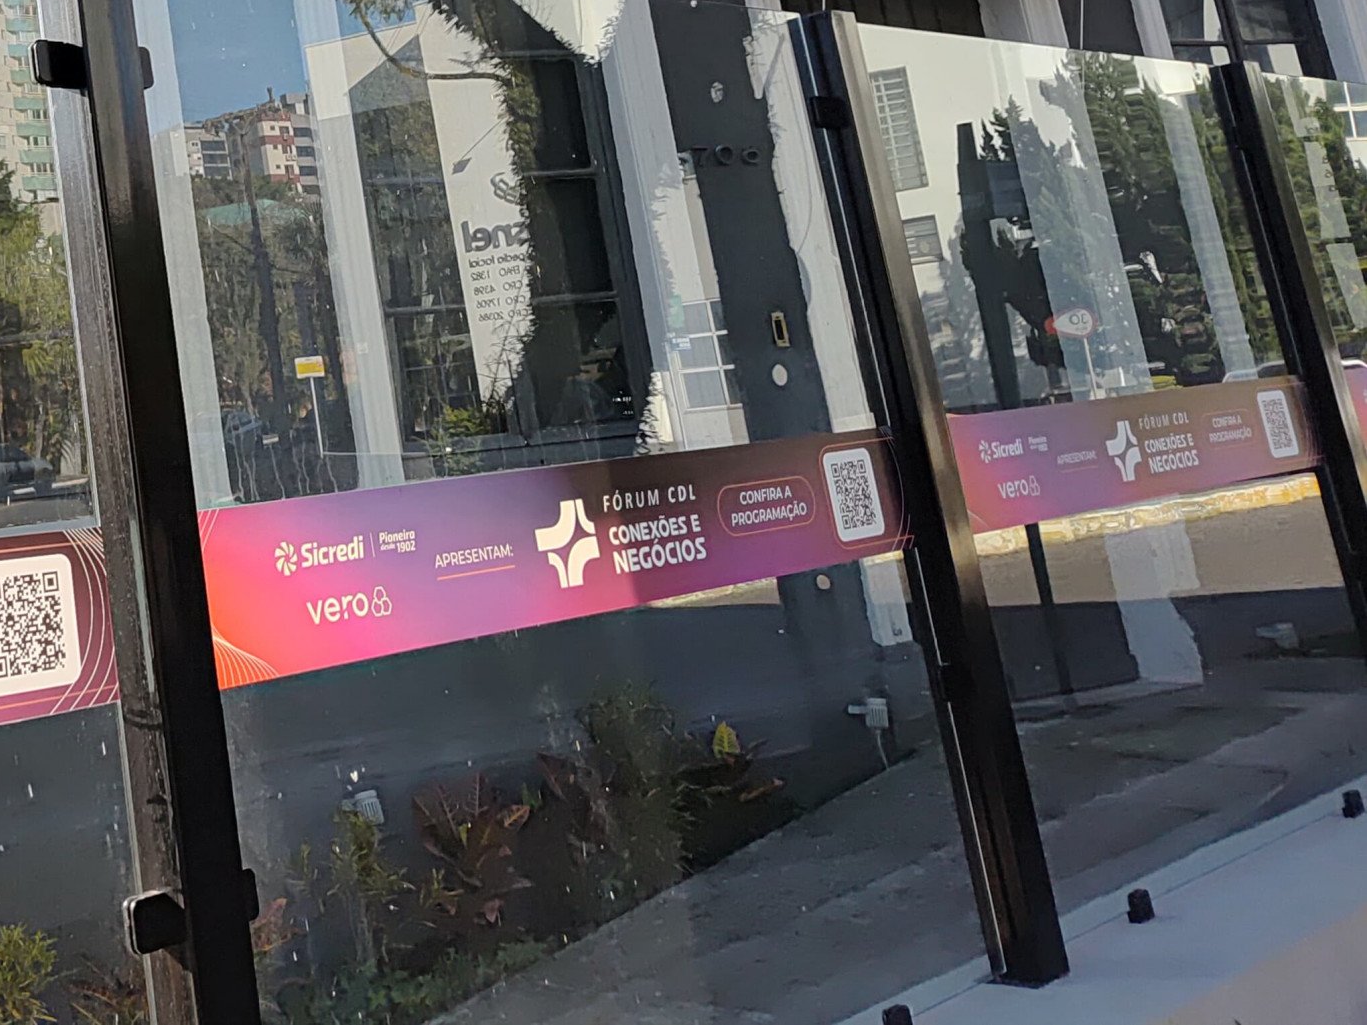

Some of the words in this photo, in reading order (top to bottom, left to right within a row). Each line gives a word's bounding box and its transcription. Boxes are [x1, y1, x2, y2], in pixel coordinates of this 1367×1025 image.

[1138, 413, 1170, 430] FÓRUM
[1174, 411, 1189, 425] CDL
[991, 438, 1024, 459] Sicredi
[1144, 433, 1187, 453] CONEXÕES
[1188, 433, 1195, 446] E
[1148, 449, 1199, 474] NEGÓCIOS
[603, 489, 660, 513] FÓRUM
[667, 484, 696, 503] CDL
[739, 486, 783, 505] CONFIRA
[784, 485, 792, 497] A
[998, 478, 1029, 499] vero
[731, 501, 807, 527] PROGRAMAÇÃO
[379, 529, 416, 544] Pioneira
[609, 515, 687, 545] CONEXÕES
[690, 514, 701, 532] E
[300, 535, 364, 568] Sicredi
[396, 540, 416, 553] 1902
[435, 543, 514, 568] APRESENTAM:
[613, 536, 707, 575] NEGÓCIOS
[306, 592, 369, 625] vero
